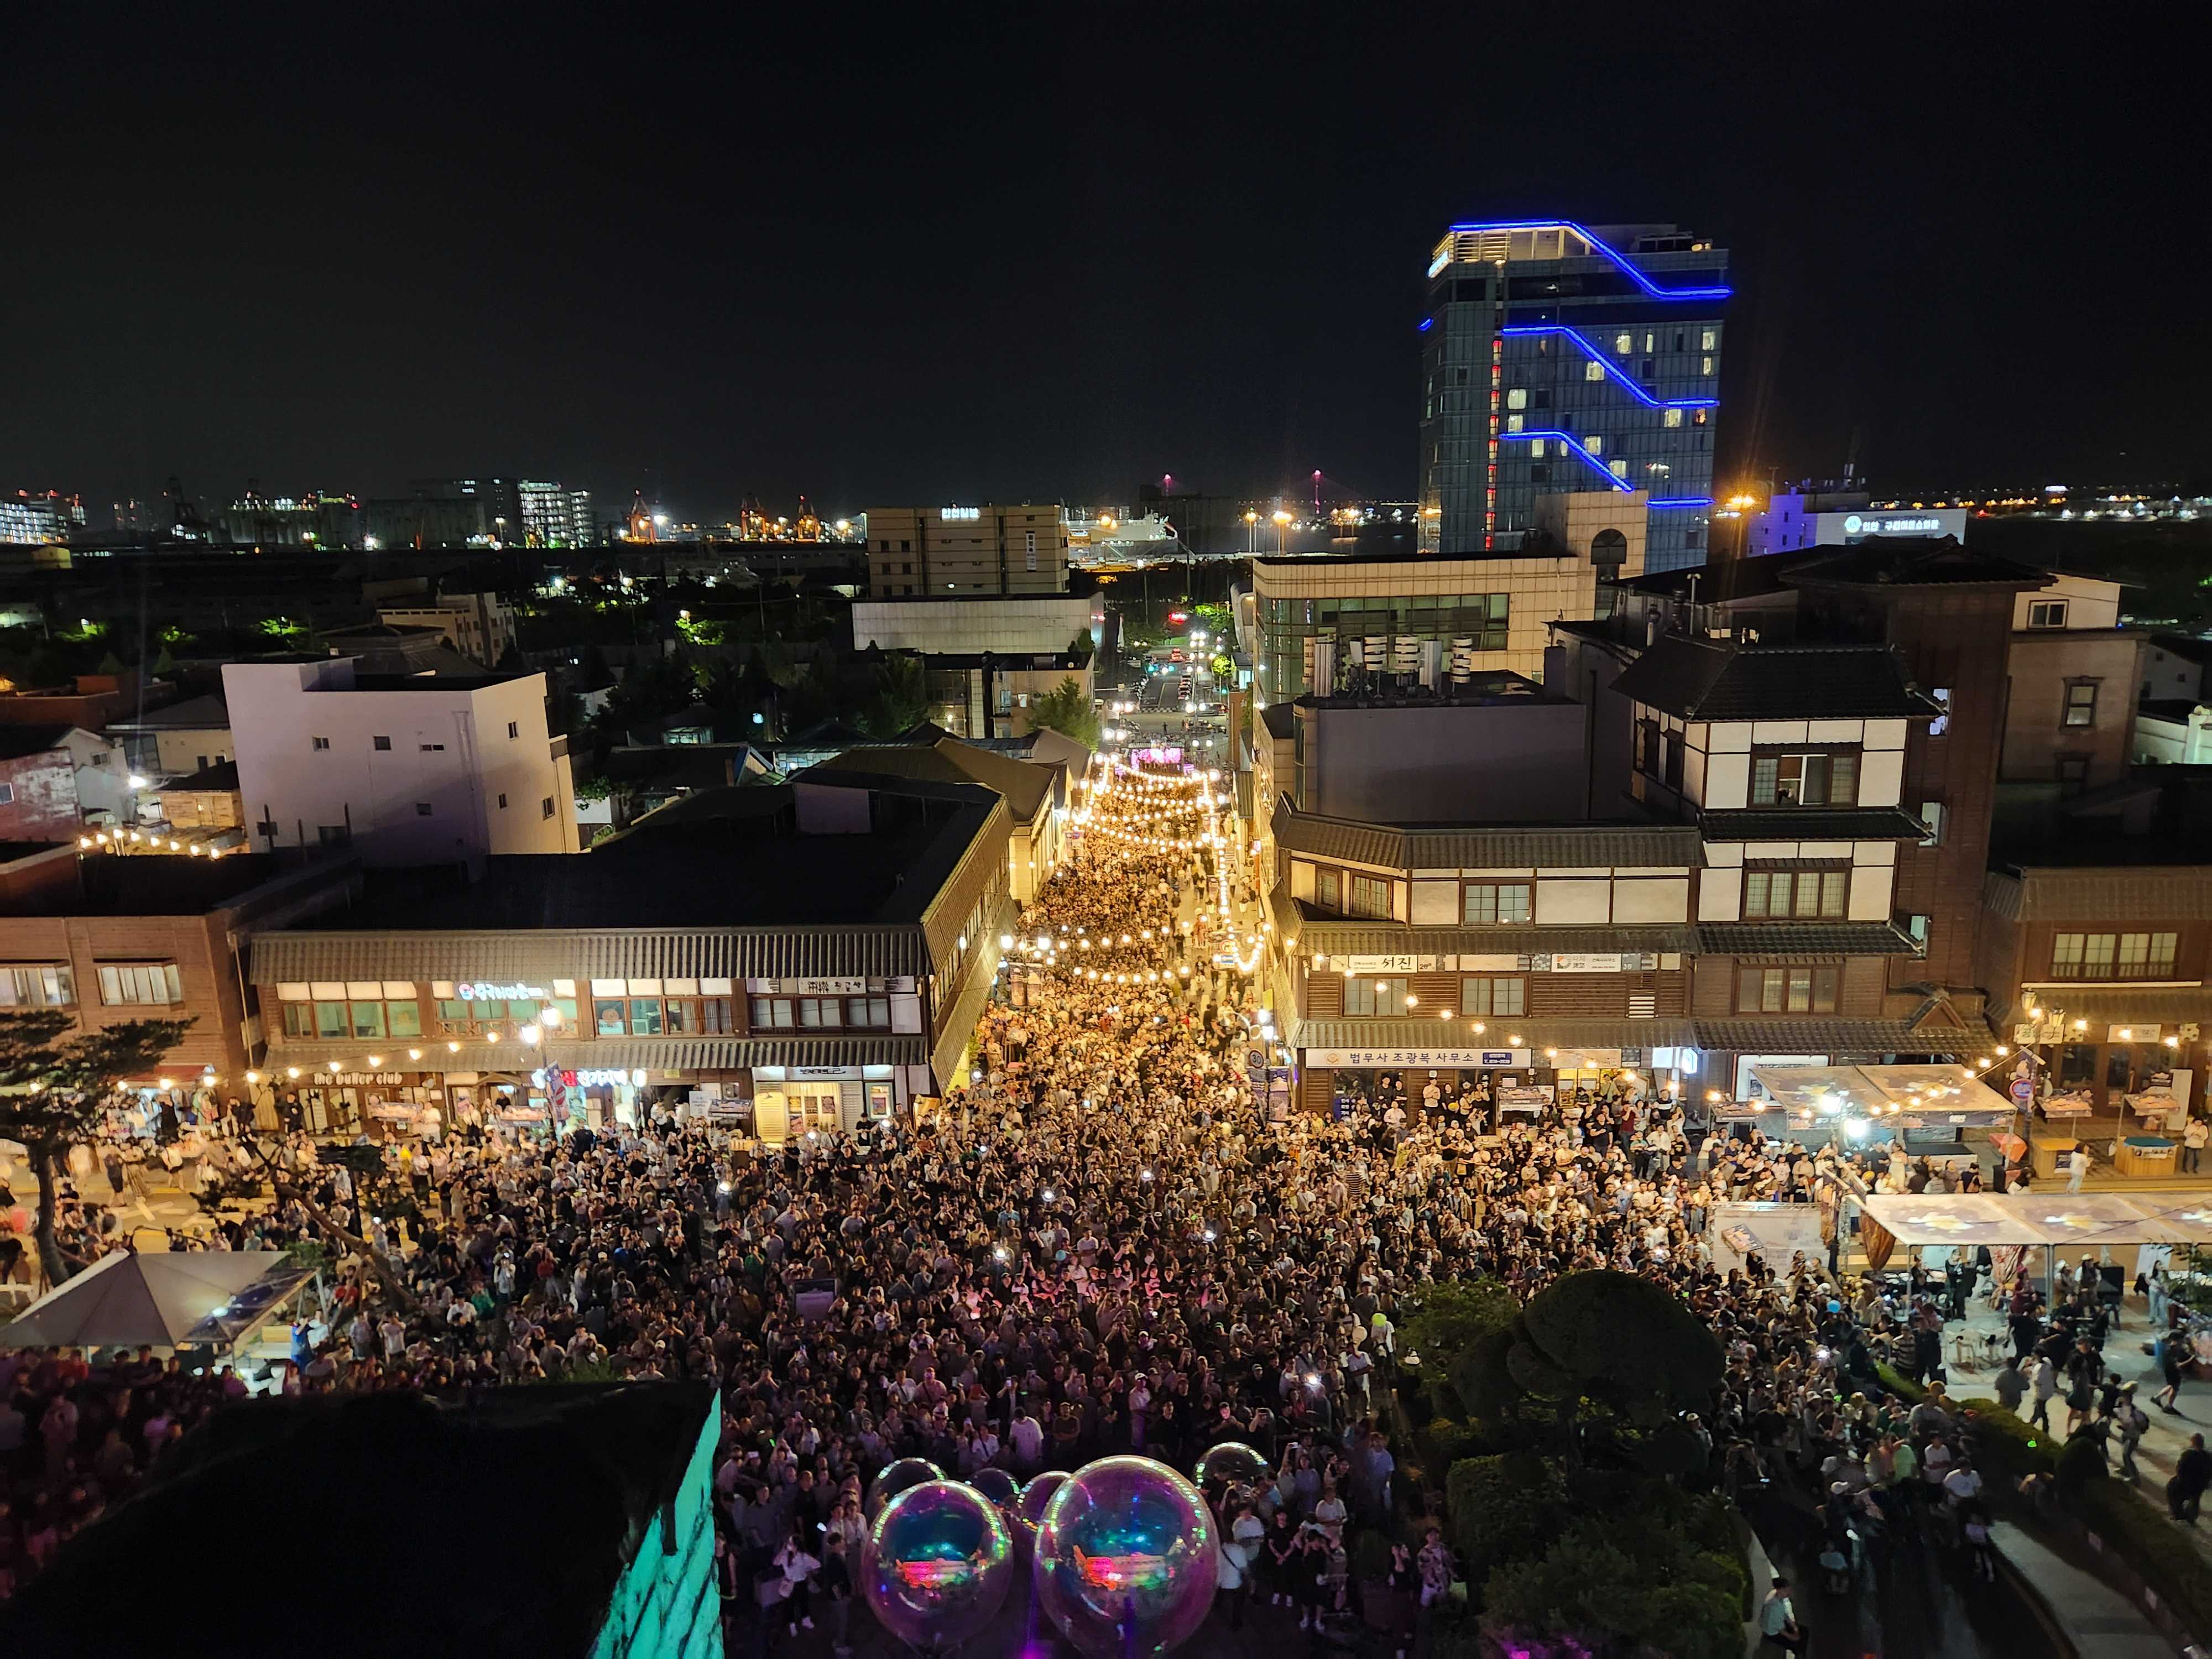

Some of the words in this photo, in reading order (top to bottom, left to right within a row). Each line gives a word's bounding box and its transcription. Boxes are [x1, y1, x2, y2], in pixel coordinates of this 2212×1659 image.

[1381, 957, 1412, 971] 서진
[1252, 1054, 1262, 1065] 30
[1350, 1052, 1387, 1064] 법무사
[1392, 1052, 1431, 1064] 조광복
[1436, 1053, 1474, 1062] 사무소
[376, 1072, 402, 1085] club
